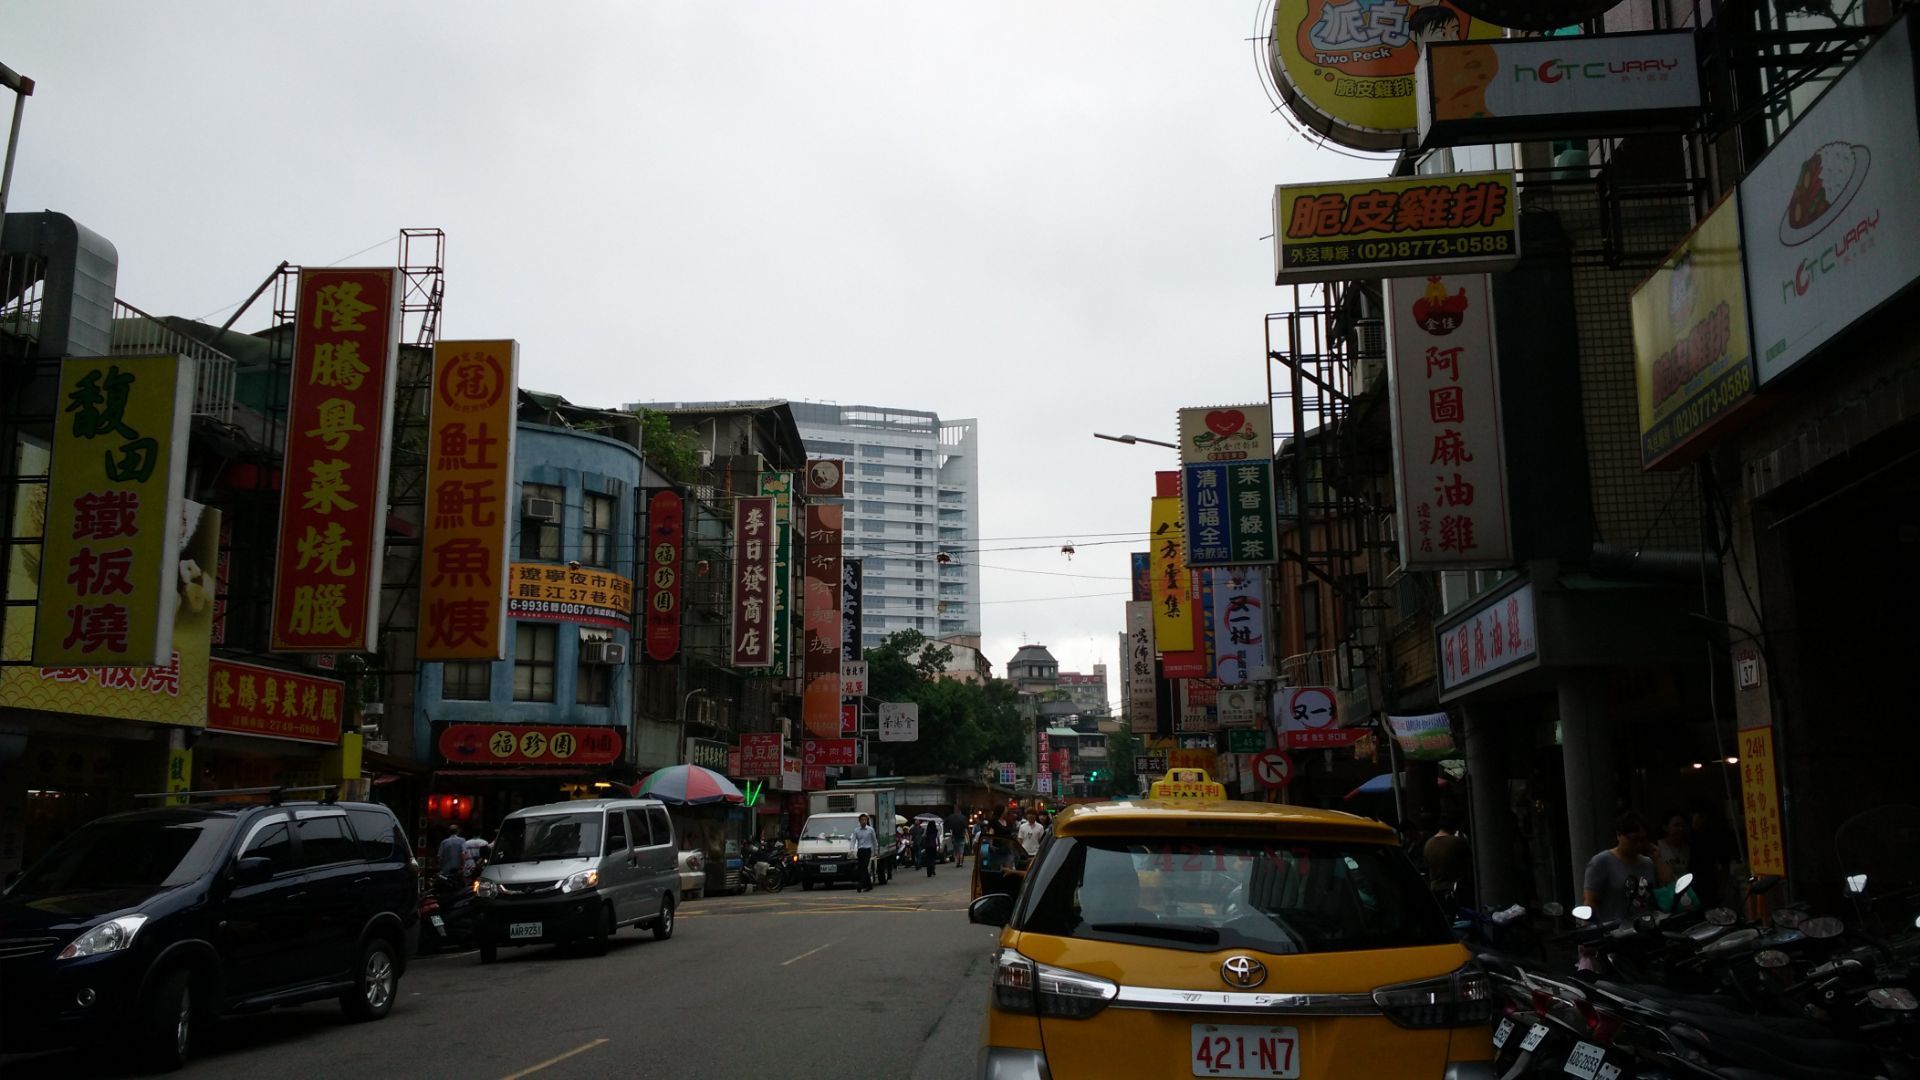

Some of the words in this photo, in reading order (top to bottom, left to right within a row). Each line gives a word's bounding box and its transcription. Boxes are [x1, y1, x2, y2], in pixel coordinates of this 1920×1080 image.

[1315, 52, 1348, 65] Two
[1353, 46, 1392, 62] Peck
[1335, 79, 1413, 98] 脆皮雞排
[1286, 181, 1507, 239] 脆皮雞排
[1358, 234, 1509, 261] (02)8773-0588
[288, 280, 378, 639] 隆騰粵菜燒臘
[1425, 346, 1478, 554] 阿圖麻油雞
[1196, 469, 1221, 546] 清心福全
[1236, 466, 1266, 559] 茉香綠茶
[62, 491, 140, 653] 鐵板燒
[212, 669, 338, 723] 隆騰粵菜燒臘
[1743, 664, 1753, 683] 37
[492, 732, 571, 756] 福珍園
[1746, 736, 1766, 759] 24H
[1196, 1035, 1295, 1071] 421-N7
